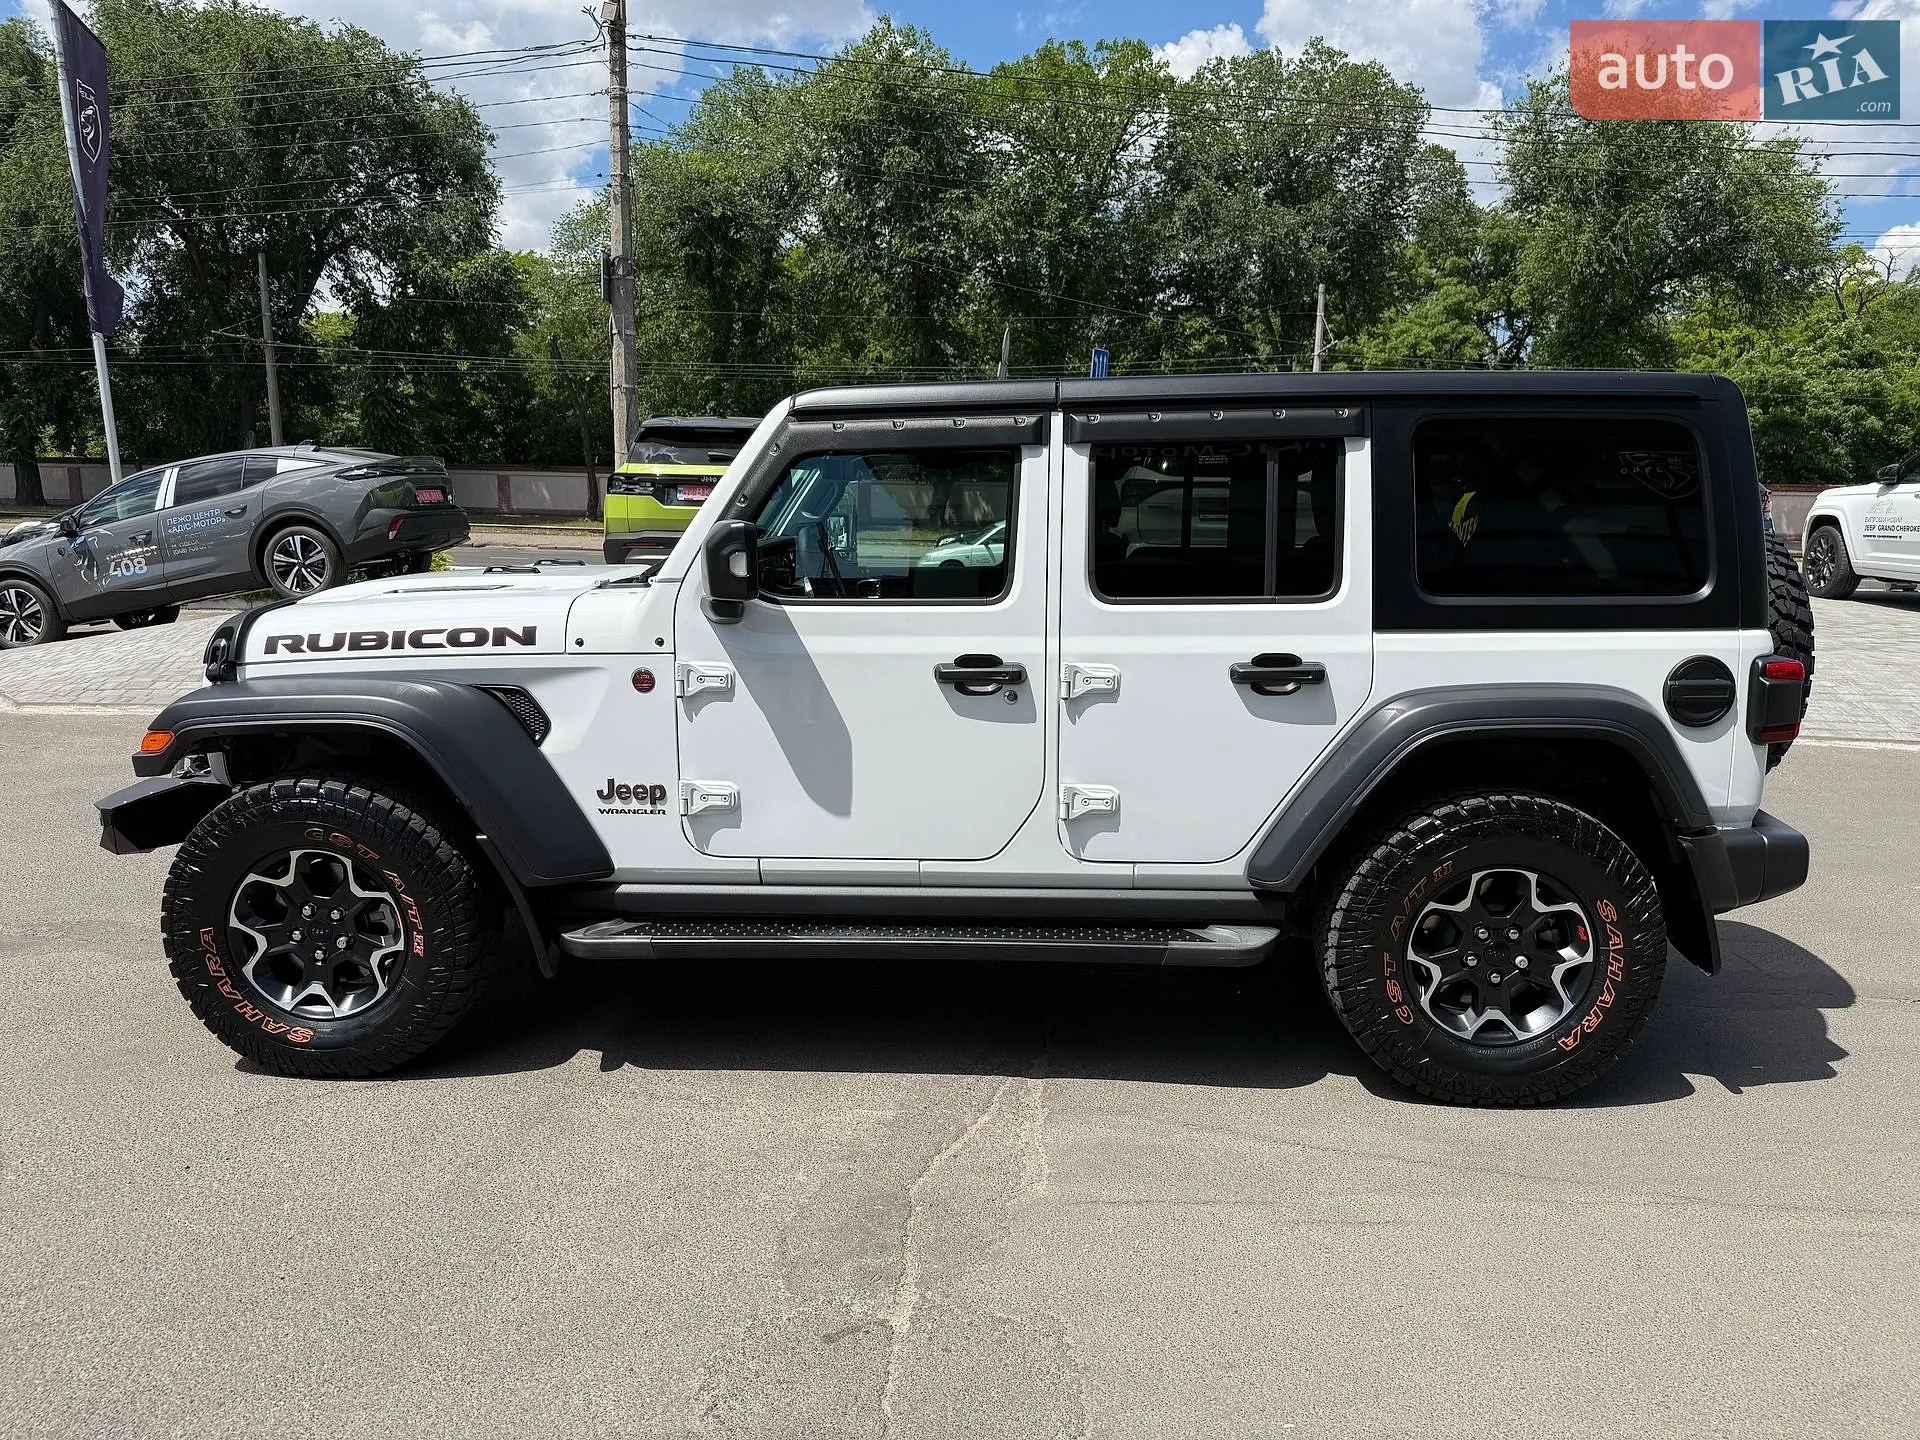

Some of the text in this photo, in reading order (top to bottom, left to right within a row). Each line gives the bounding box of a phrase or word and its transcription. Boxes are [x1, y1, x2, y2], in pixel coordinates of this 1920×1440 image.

[166, 508, 221, 526] ПЕЖО ЦЕНТР
[109, 557, 148, 577] 408
[264, 625, 538, 655] RUBICON
[596, 777, 667, 805] Jeep
[303, 827, 382, 862] CST
[198, 926, 315, 1045] SAHARA
[1383, 951, 1414, 1025] CST
[1556, 897, 1624, 1052] SAHARA
